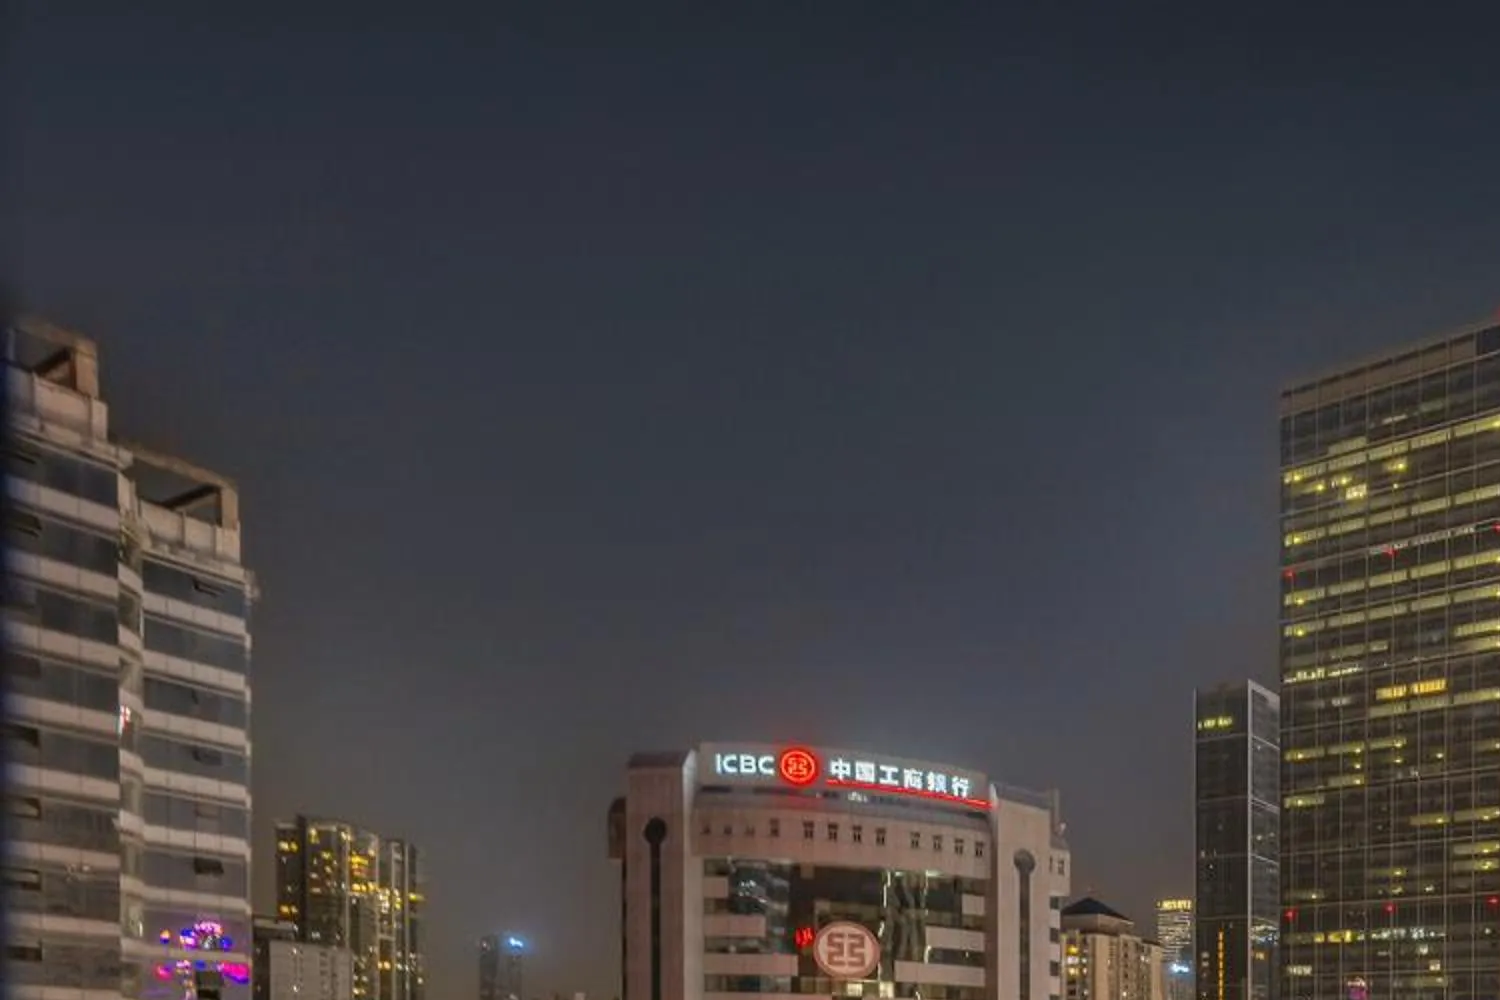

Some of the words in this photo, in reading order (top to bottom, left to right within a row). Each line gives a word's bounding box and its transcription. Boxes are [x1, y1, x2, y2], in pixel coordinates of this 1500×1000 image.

[714, 753, 775, 776] ICBC
[829, 757, 970, 798] 中国工商银行
